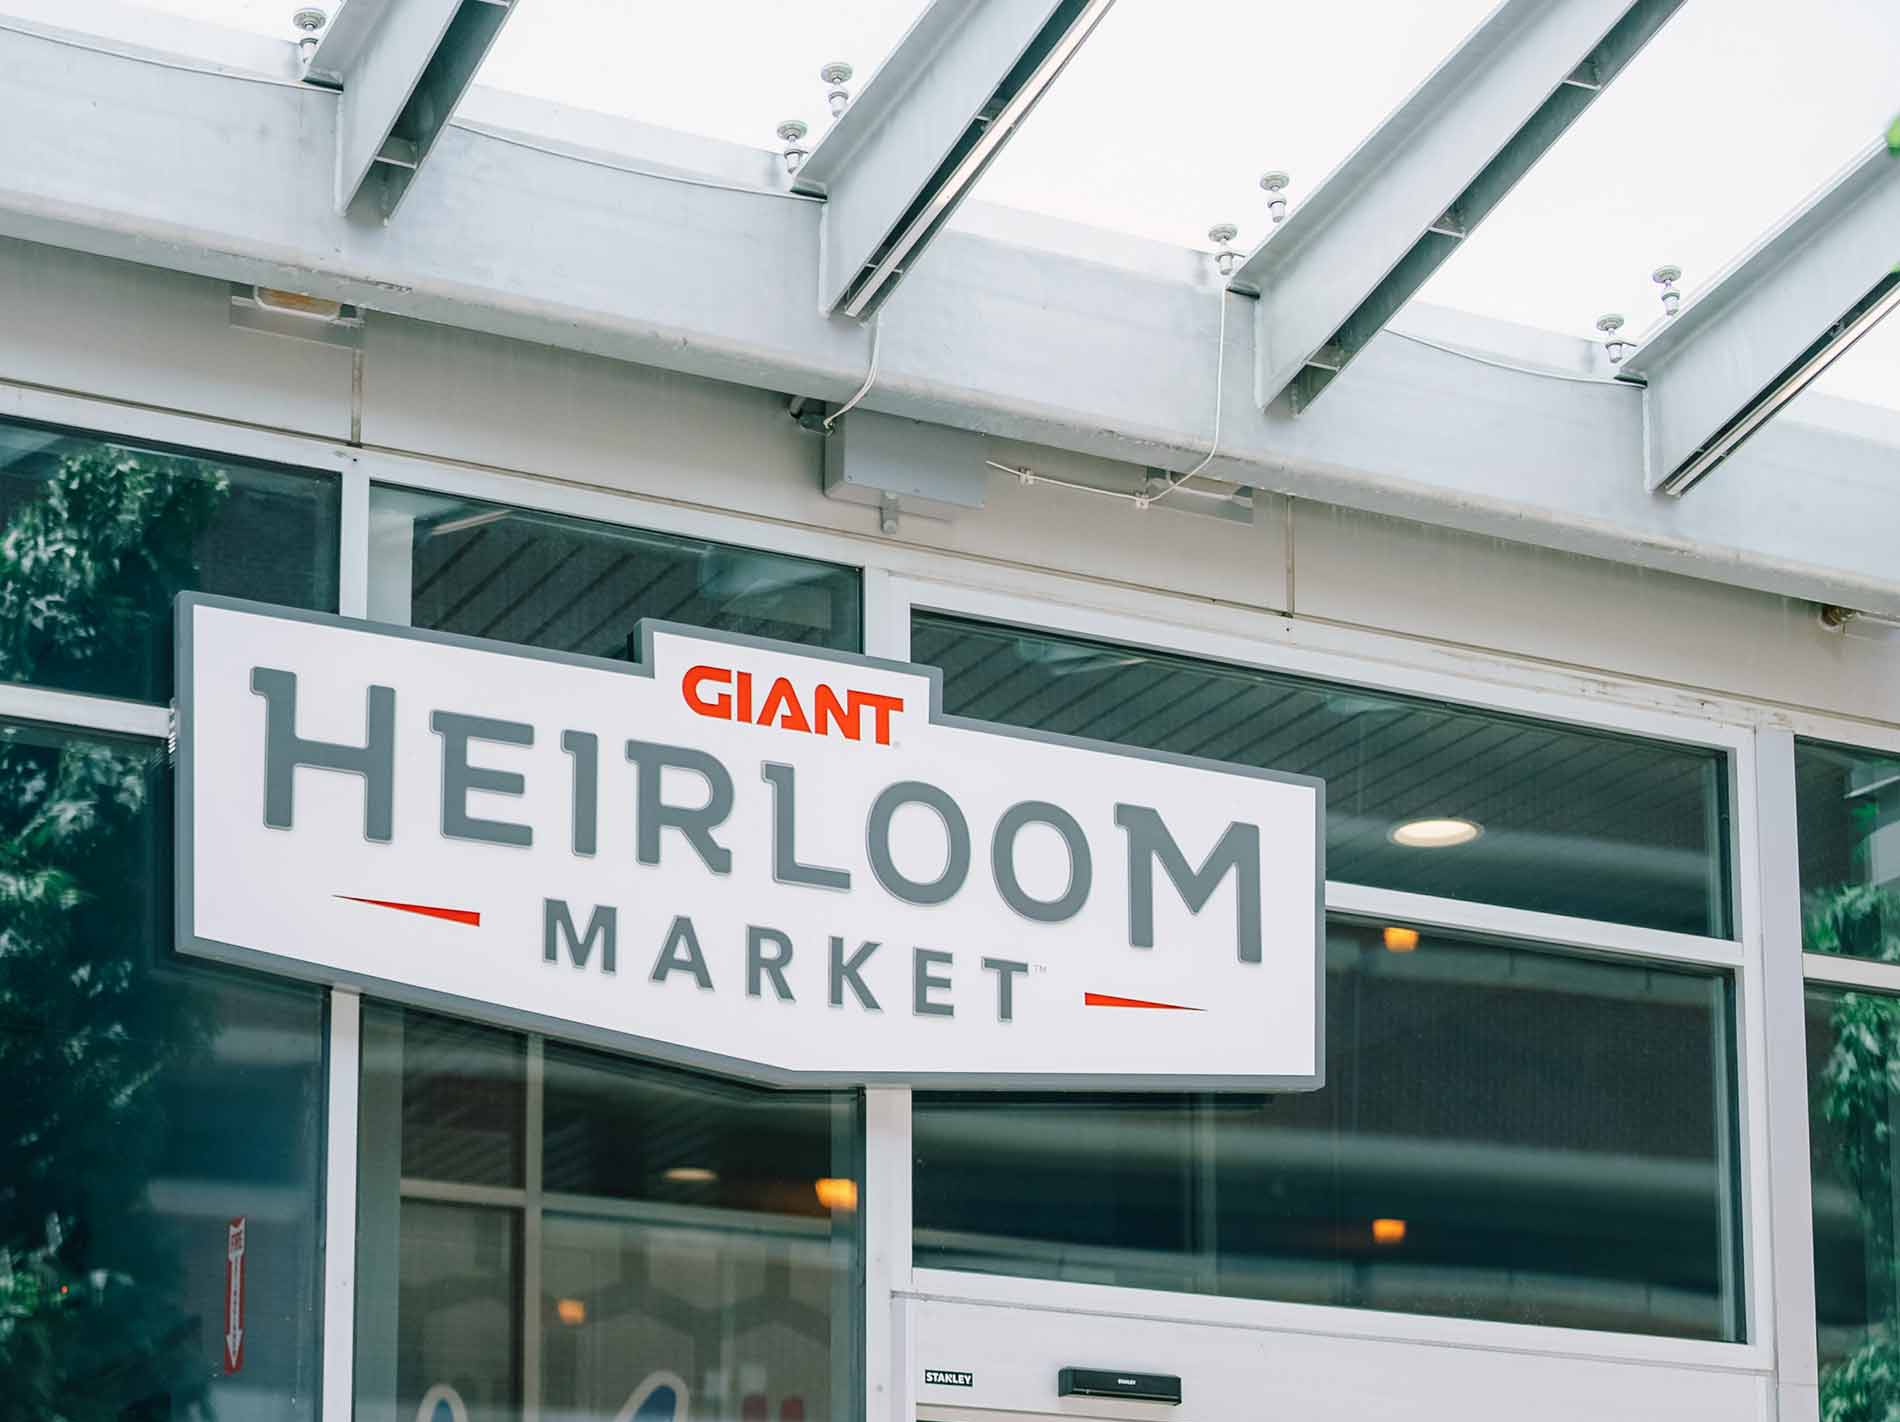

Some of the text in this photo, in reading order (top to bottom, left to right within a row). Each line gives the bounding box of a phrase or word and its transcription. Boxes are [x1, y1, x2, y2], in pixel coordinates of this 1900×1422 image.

[682, 664, 904, 746] GIANT
[250, 666, 1262, 964] HEIRLOOM
[543, 897, 1030, 1023] MARKET
[926, 1371, 972, 1385] STANLEY
